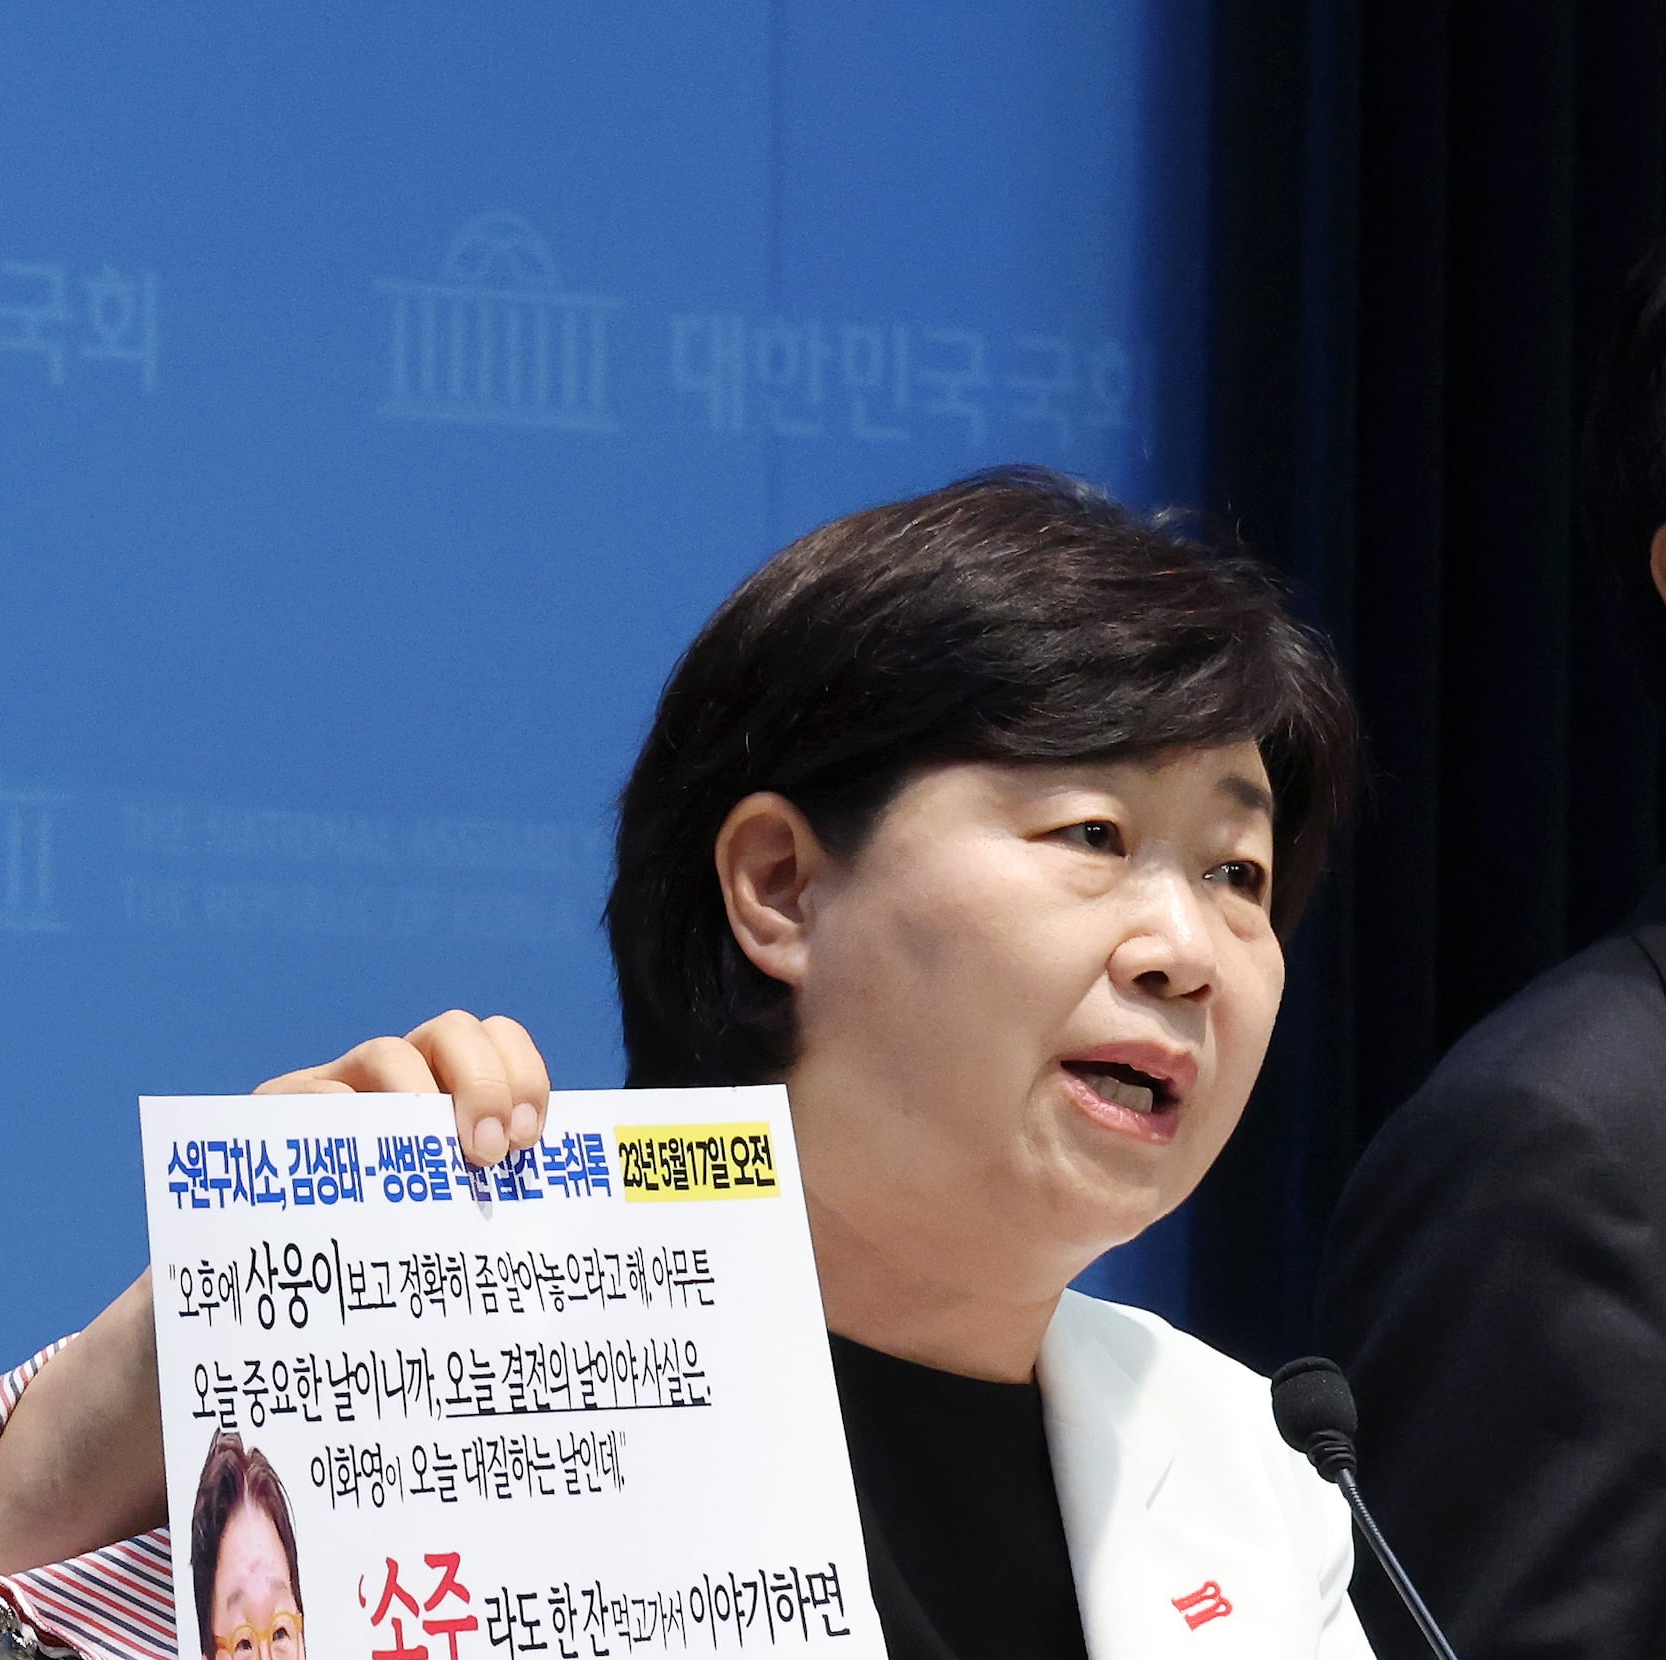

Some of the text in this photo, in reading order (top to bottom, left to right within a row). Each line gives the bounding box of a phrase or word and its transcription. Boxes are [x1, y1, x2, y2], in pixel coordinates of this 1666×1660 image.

[168, 1138, 286, 1212] 수원구치소,
[541, 1132, 611, 1198] 녹취록
[731, 1134, 775, 1187] 오전
[399, 1251, 471, 1318] 정확히
[652, 1245, 715, 1309] 아무튼
[193, 1337, 711, 1428] 오늘 중요한 날이니까, 오늘 결전의 날이야 사실은.
[310, 1443, 404, 1509] 이화영이
[410, 1443, 458, 1502] 오늘
[461, 1434, 555, 1500] 대질하는
[690, 1561, 851, 1649] 이야기하면
